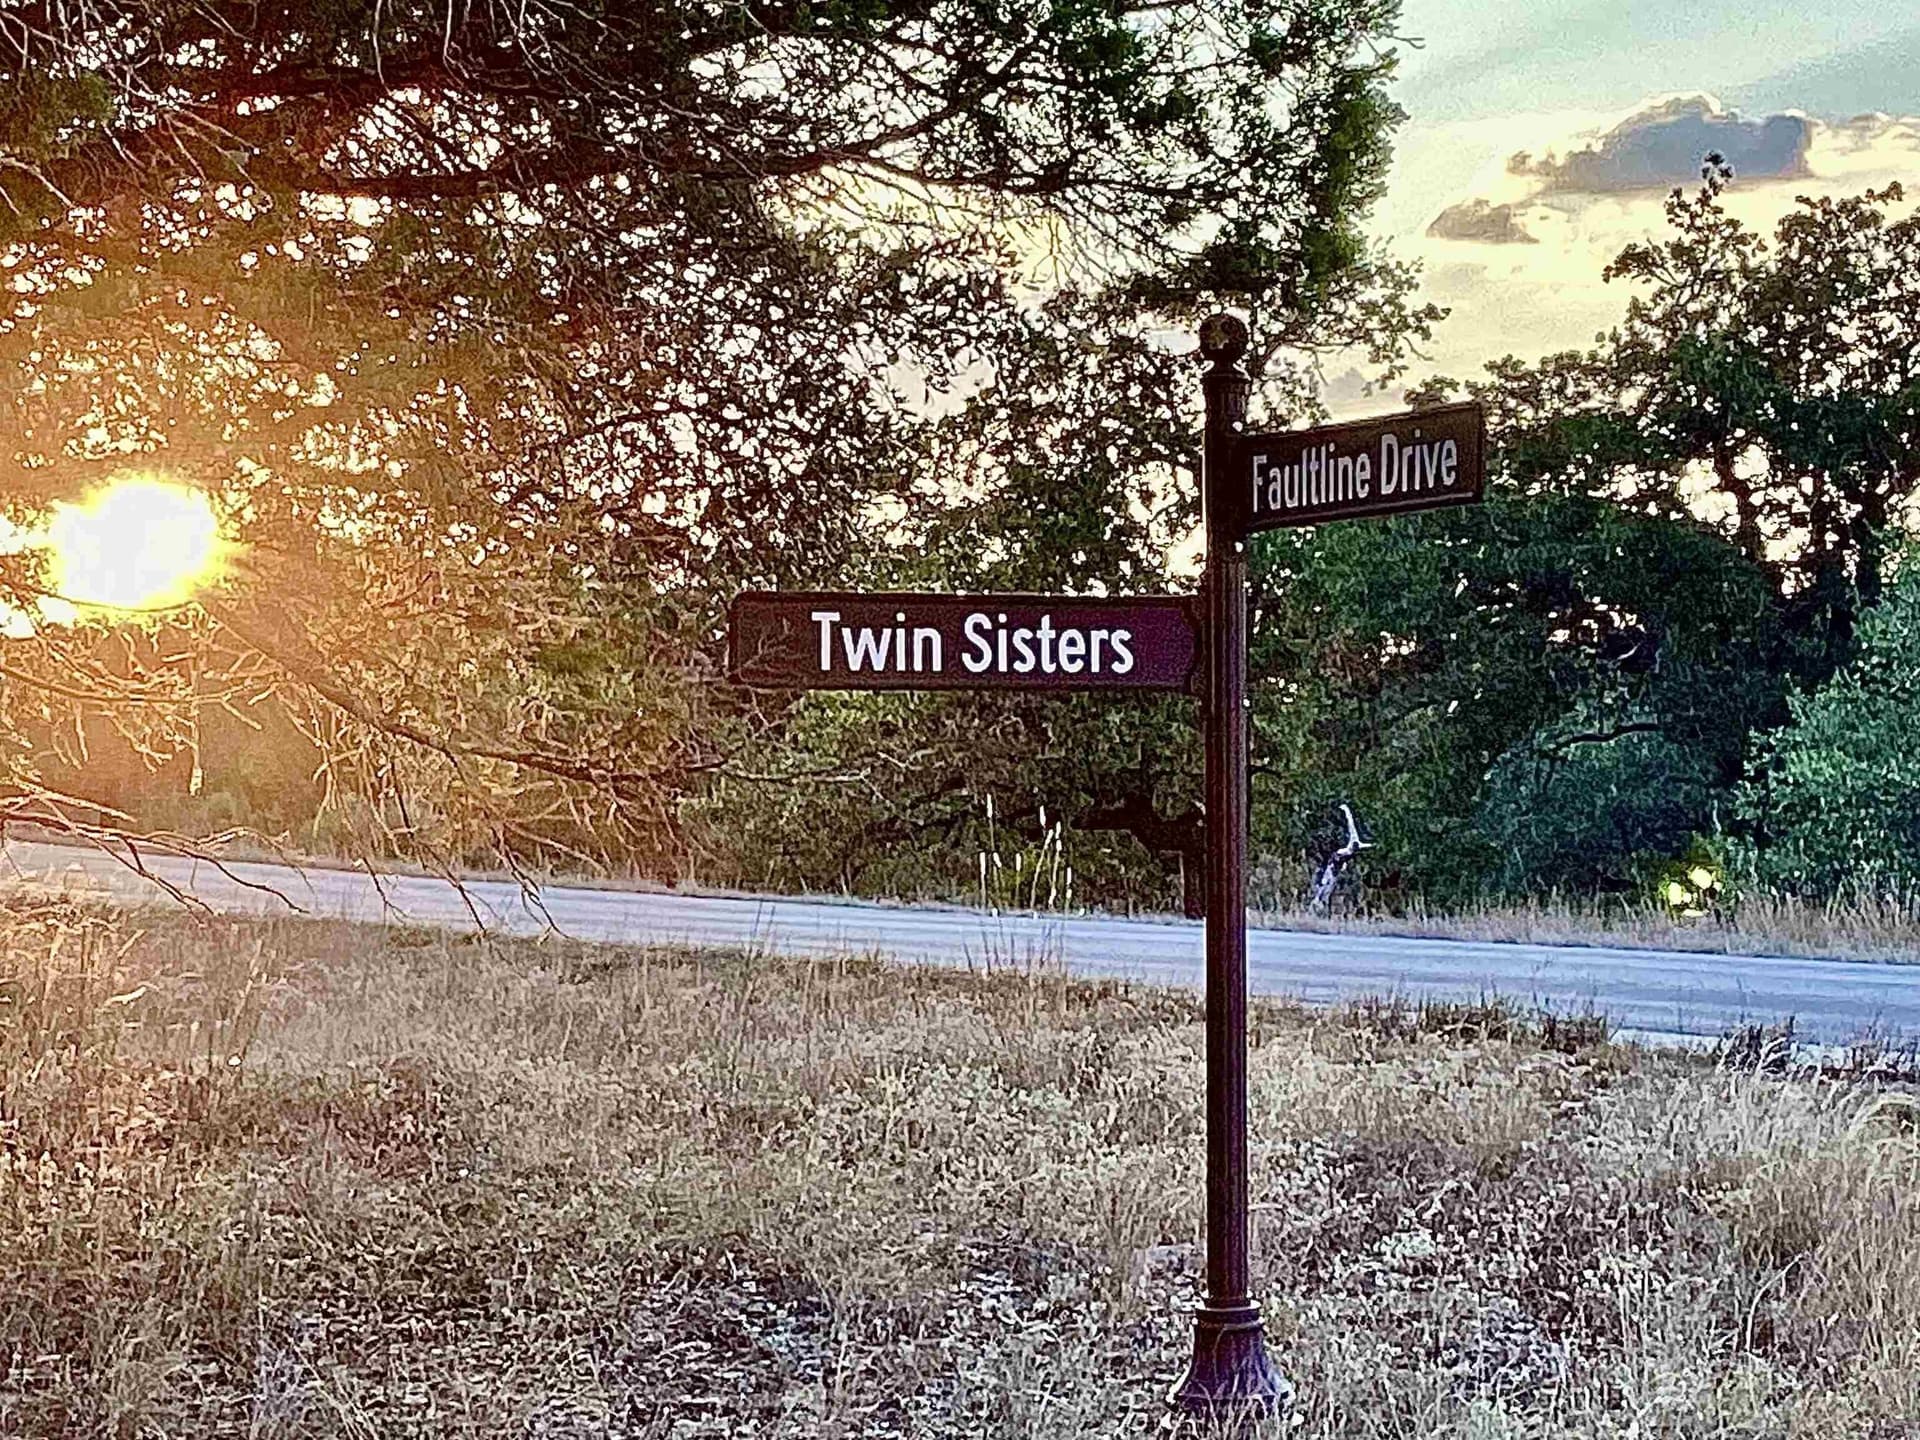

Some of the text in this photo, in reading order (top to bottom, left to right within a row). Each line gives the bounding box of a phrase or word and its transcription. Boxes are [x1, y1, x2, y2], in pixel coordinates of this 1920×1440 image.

[1252, 428, 1458, 513] Faultline Drive
[811, 611, 1134, 674] Twin Sisters
